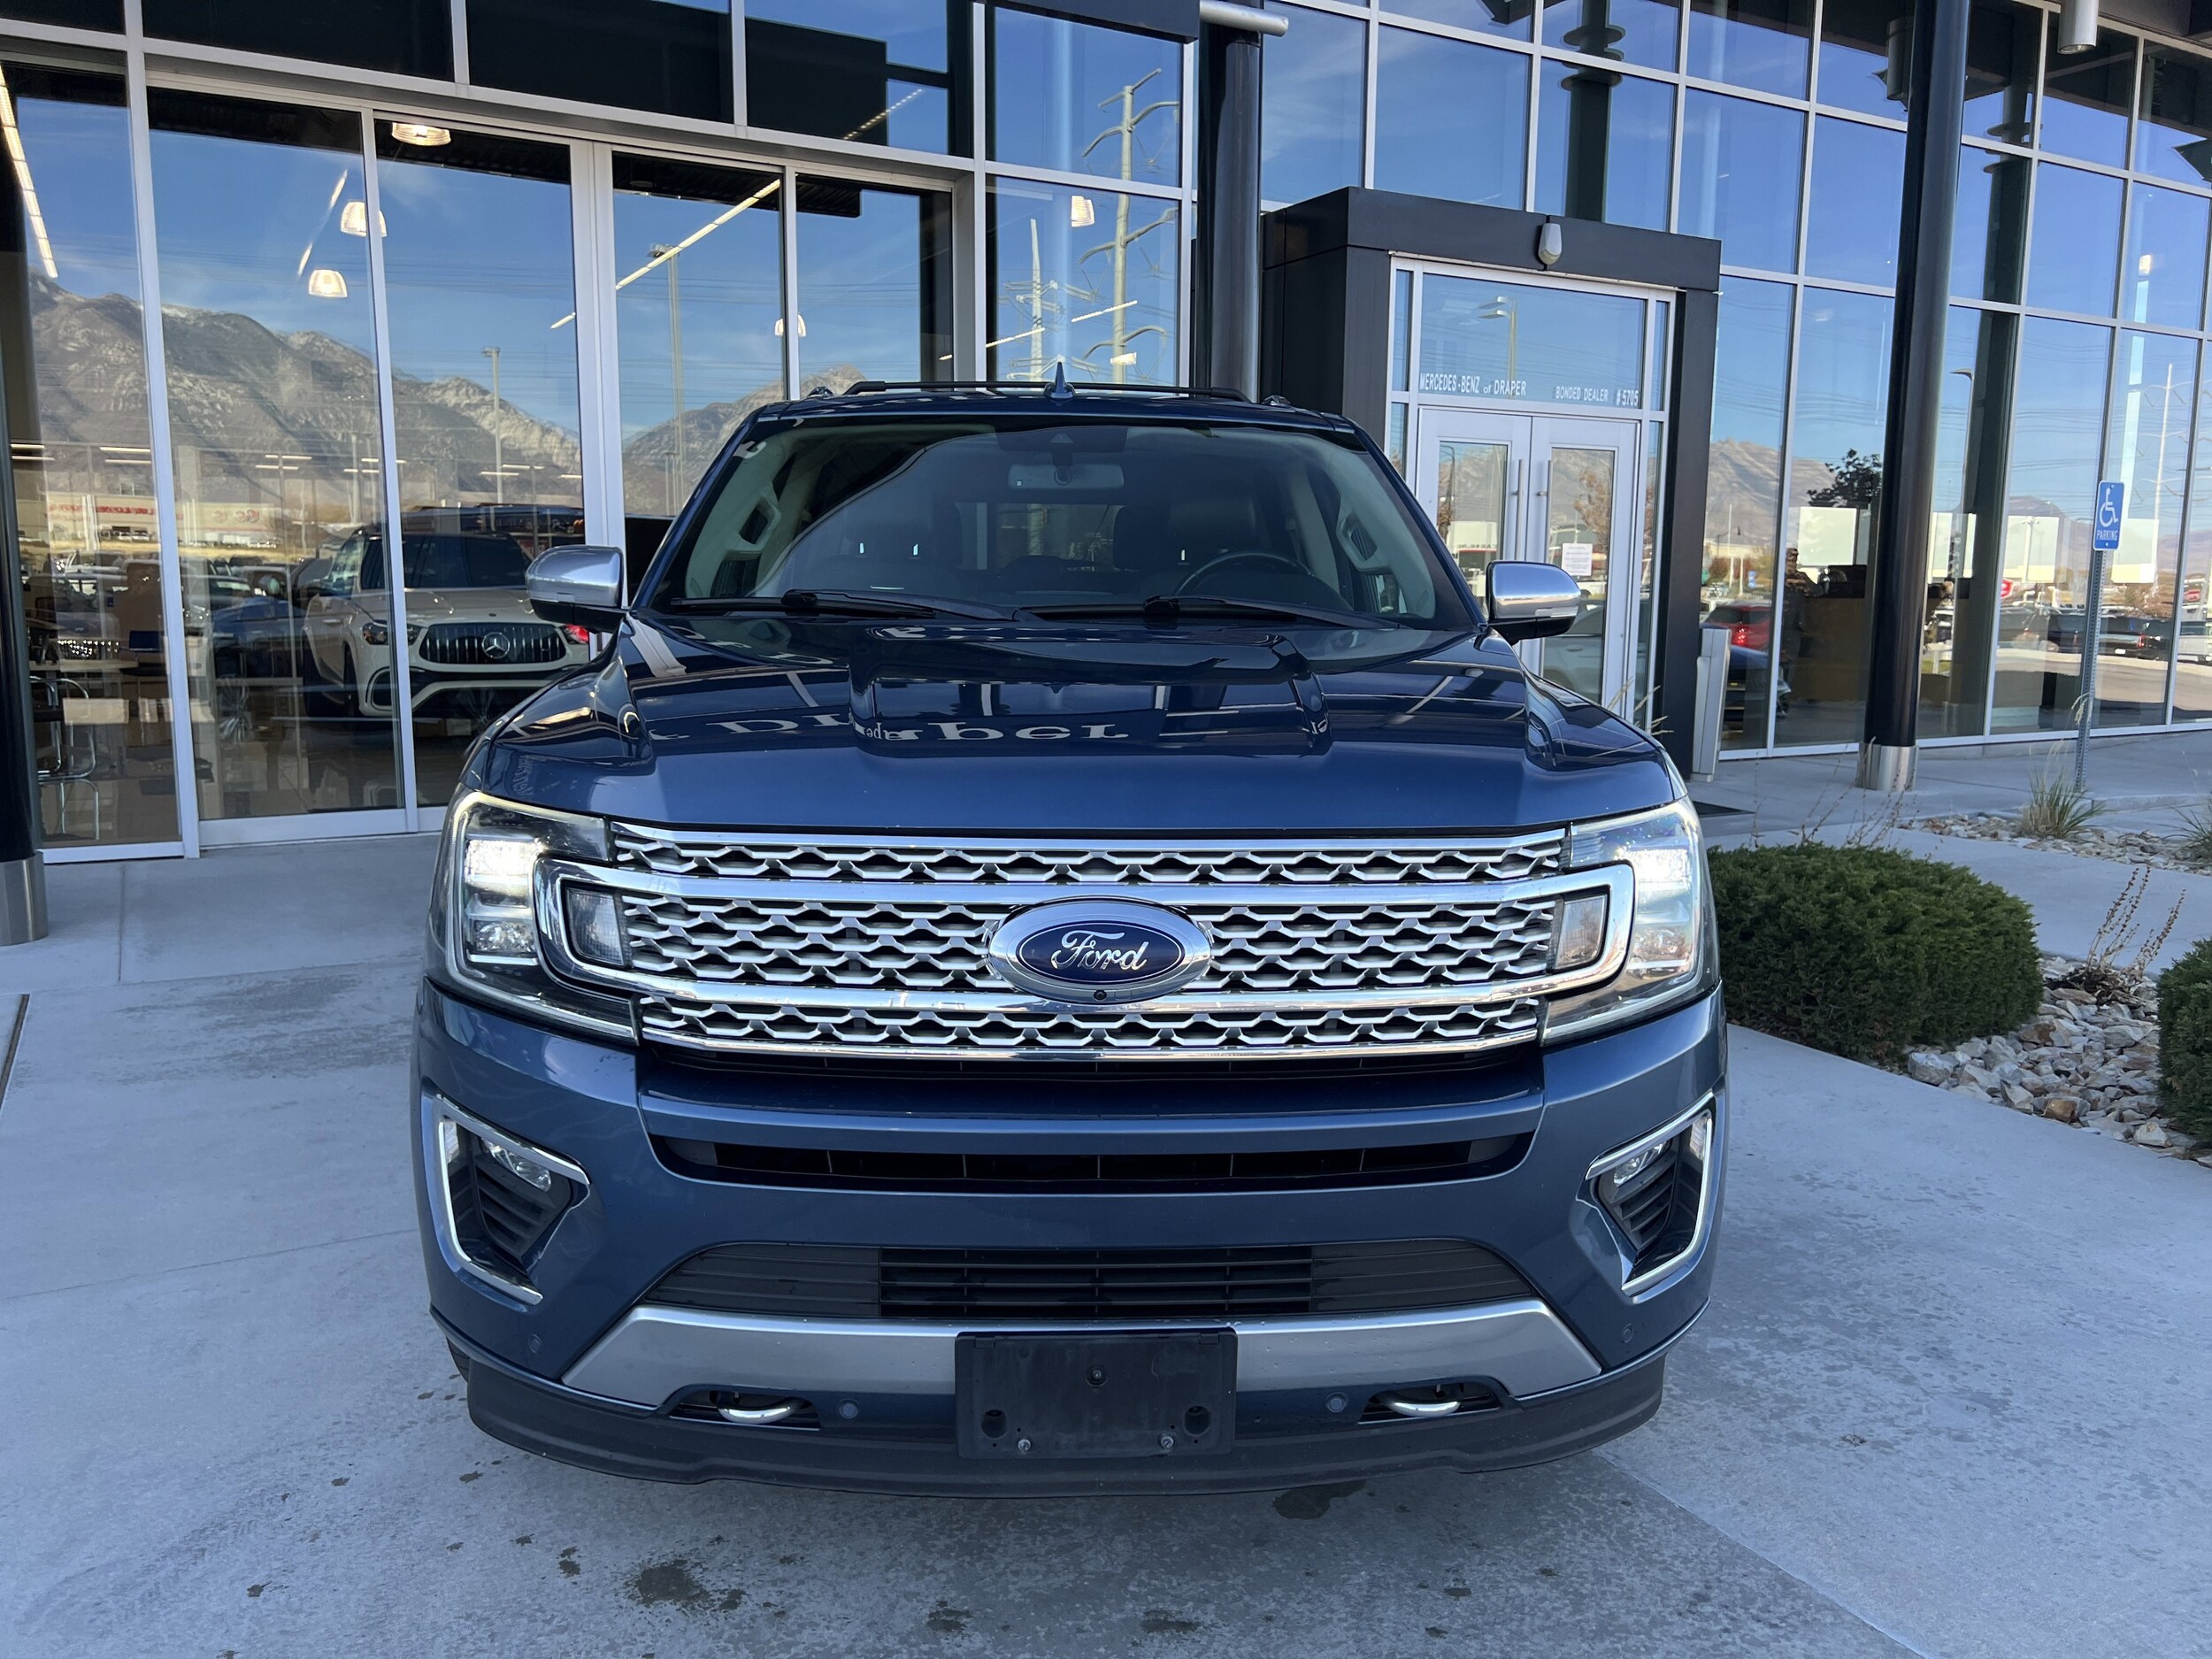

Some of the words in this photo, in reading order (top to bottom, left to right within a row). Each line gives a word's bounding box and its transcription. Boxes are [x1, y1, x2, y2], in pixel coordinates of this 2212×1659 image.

[1483, 384, 1492, 394] of
[1494, 380, 1526, 396] DRAPER
[1555, 386, 1581, 400] BONDED
[1584, 388, 1609, 402] DEALER
[2096, 529, 2118, 541] PARKING
[1051, 930, 1149, 971] Ford
